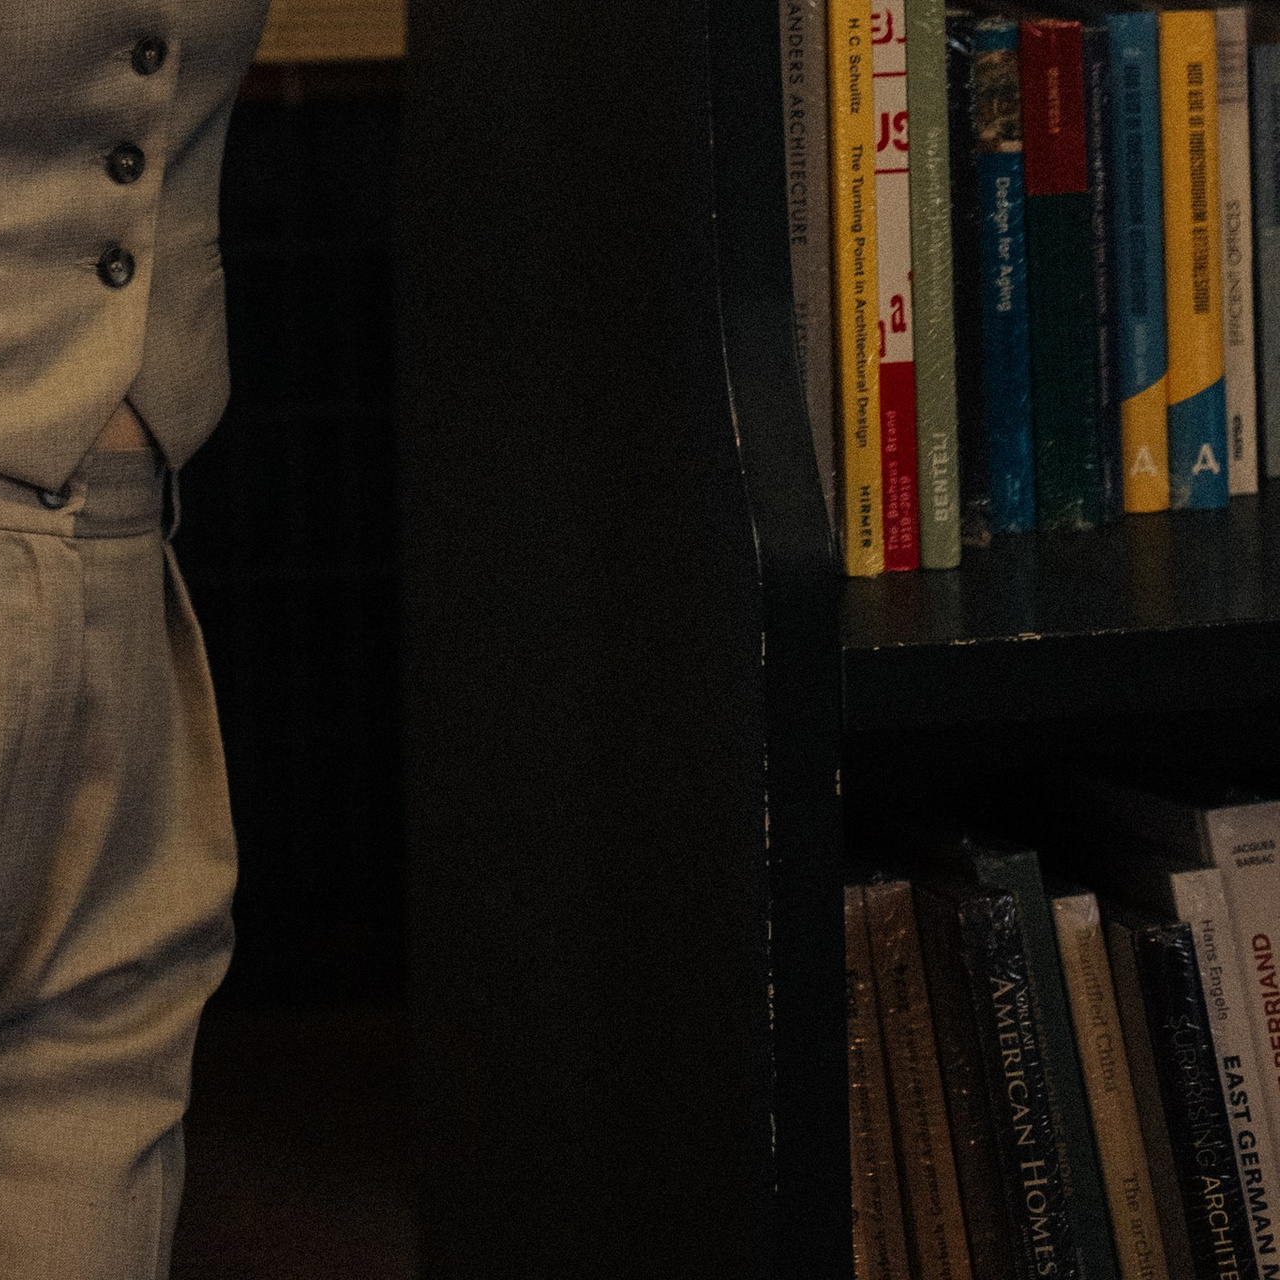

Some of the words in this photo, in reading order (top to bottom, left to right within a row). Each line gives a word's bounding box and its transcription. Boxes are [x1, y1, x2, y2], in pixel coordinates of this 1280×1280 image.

[848, 54, 863, 114] Schulitz
[789, 93, 809, 246] ARCHITECTURE
[851, 143, 864, 172] The
[850, 176, 866, 233] Turning
[994, 175, 1012, 233] Design
[852, 236, 867, 277] Point
[998, 236, 1014, 261] for
[853, 279, 867, 294] in
[996, 264, 1014, 313] Aging
[854, 297, 868, 393] Architectural
[854, 397, 870, 448] Design
[884, 410, 898, 453] Brand
[886, 460, 899, 518] Bauhaus
[932, 432, 949, 522] BENTELI
[859, 485, 873, 548] HIRMER
[888, 526, 899, 551] The
[1200, 918, 1219, 961] Hans
[1208, 965, 1231, 1021] Engels
[1094, 1033, 1119, 1093] China
[1169, 1014, 1218, 1167] SURPRISING
[1223, 1054, 1251, 1122] EAST
[987, 975, 1037, 1147] AMERICAN
[1018, 1159, 1059, 1277] HOMES
[1122, 1172, 1143, 1213] The
[1236, 1130, 1277, 1254] GERMAN
